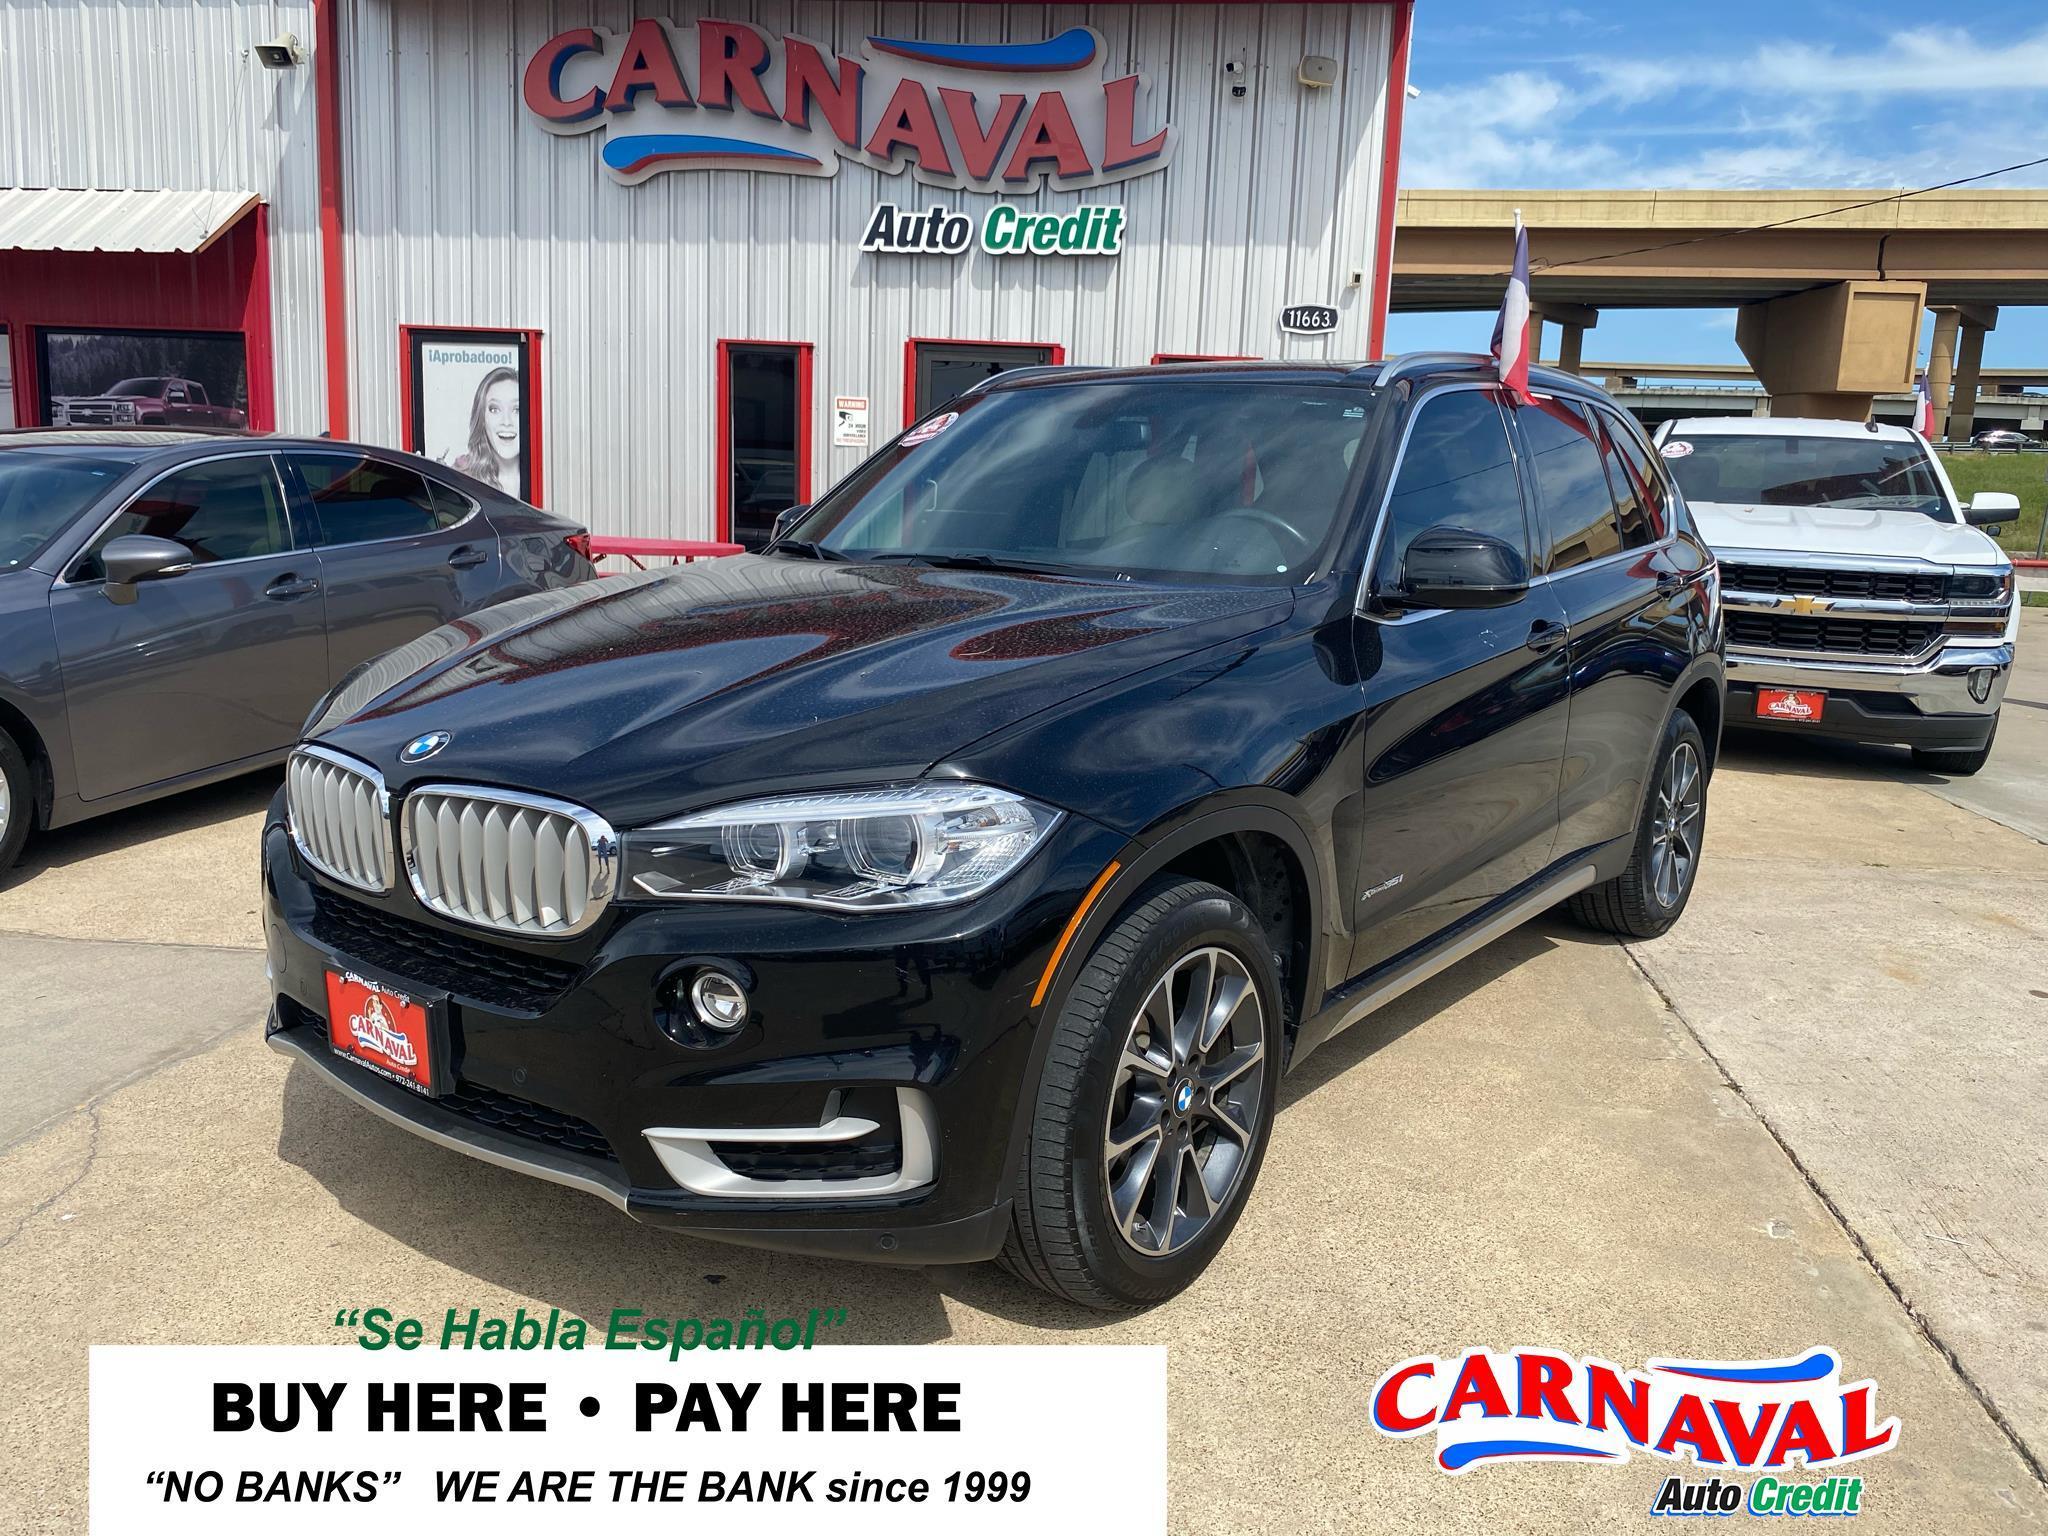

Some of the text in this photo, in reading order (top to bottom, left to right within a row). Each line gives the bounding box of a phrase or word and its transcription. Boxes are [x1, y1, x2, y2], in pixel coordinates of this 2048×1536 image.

[524, 19, 1168, 182] CARNAVAL
[864, 205, 1126, 253] Auto Credit
[1290, 310, 1330, 327] 11663
[838, 400, 865, 409] WARNING
[345, 971, 381, 993] CARNAVAL
[349, 1015, 416, 1062] CARNAVAL
